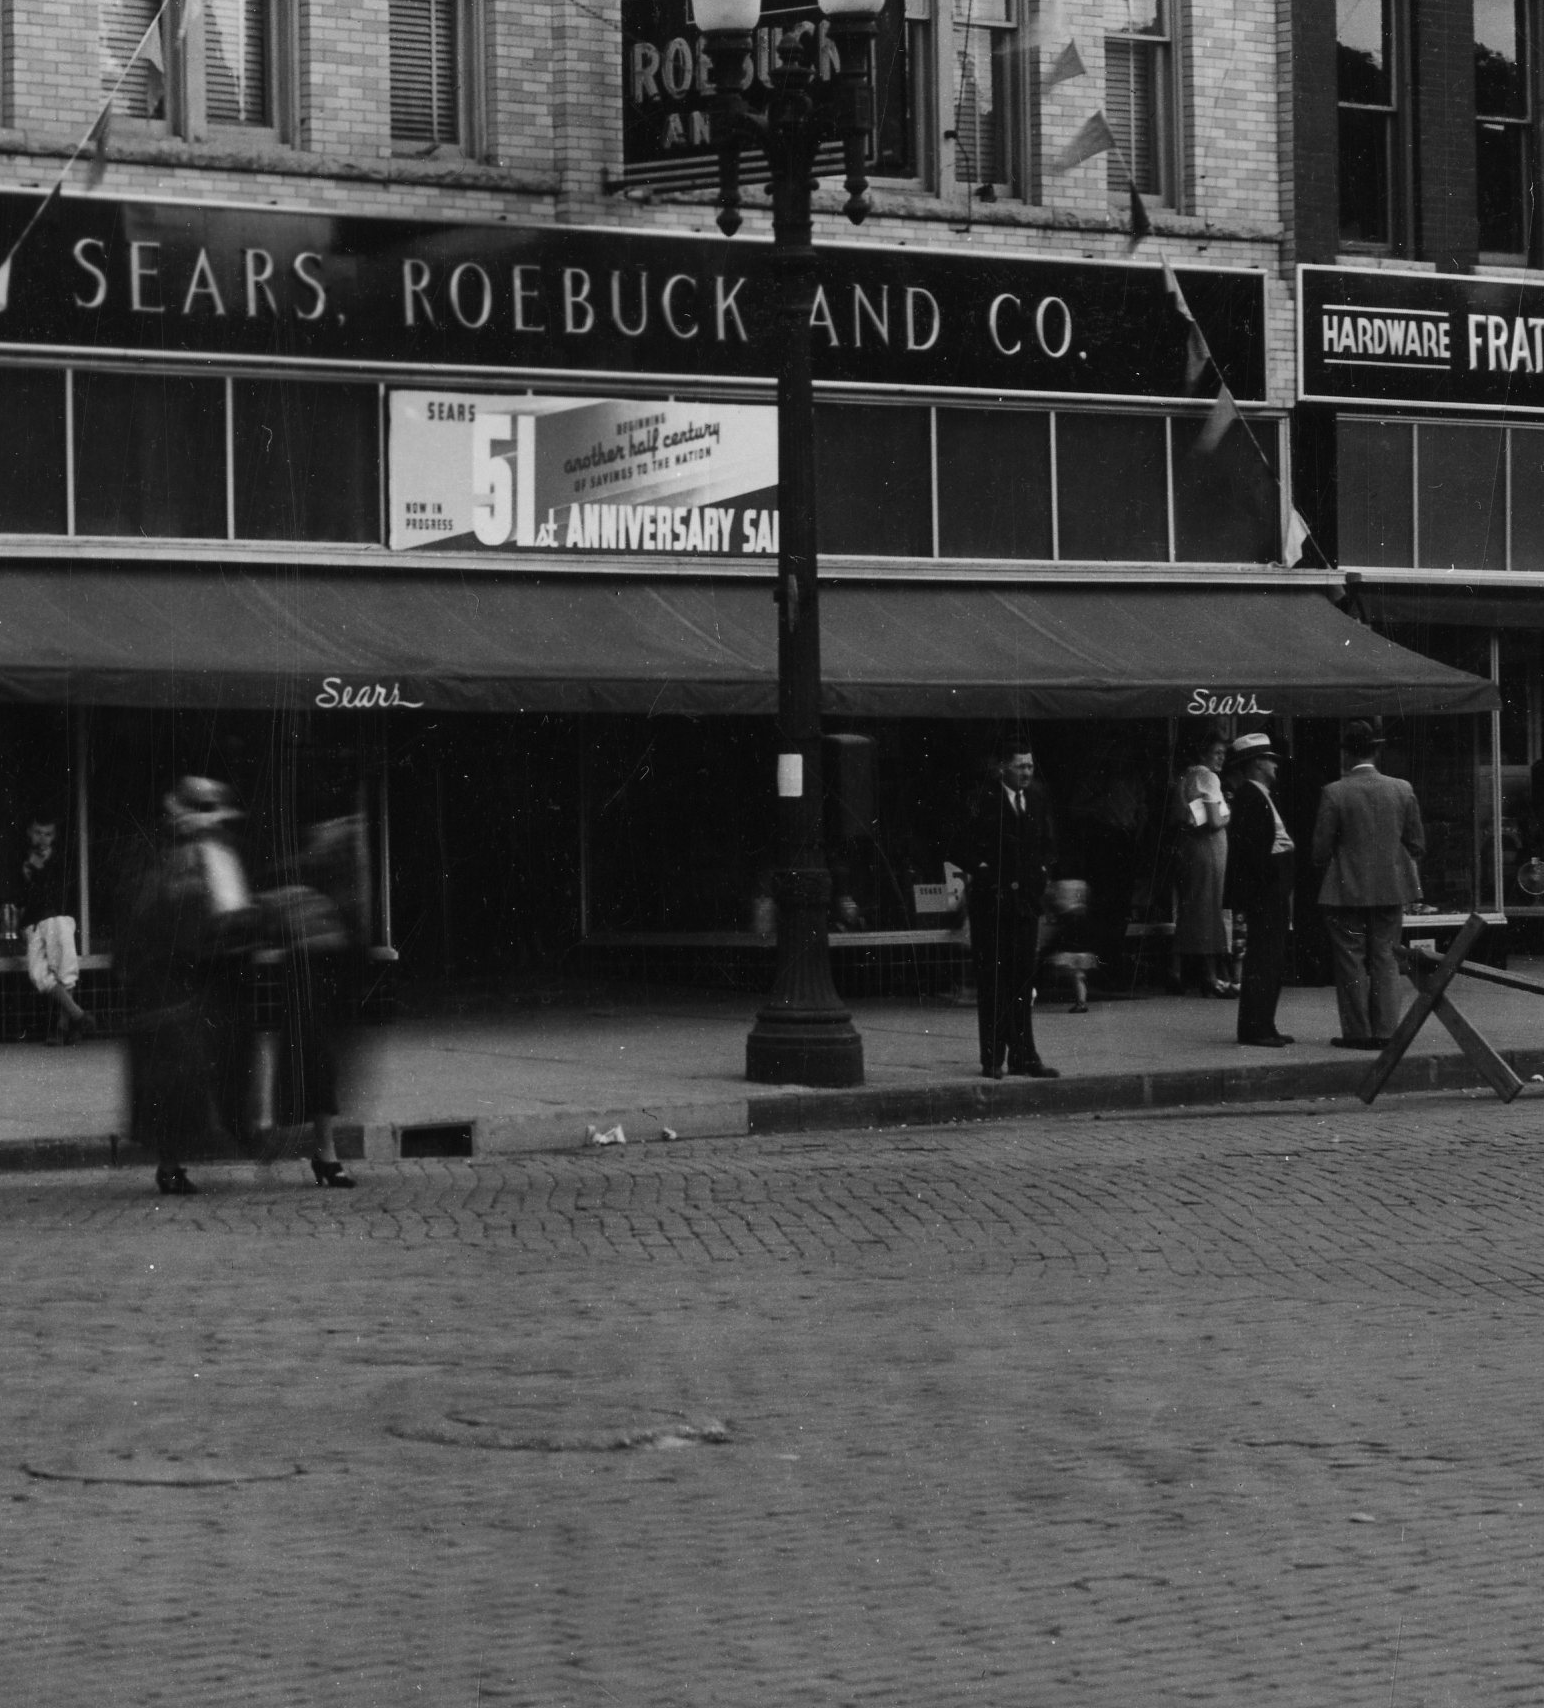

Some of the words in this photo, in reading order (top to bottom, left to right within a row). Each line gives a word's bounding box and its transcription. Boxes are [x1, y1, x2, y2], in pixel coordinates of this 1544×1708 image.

[72, 237, 346, 326] SEARS,
[401, 258, 748, 343] ROEBUCK
[808, 283, 941, 351] AND
[988, 293, 1088, 360] CO.
[1321, 314, 1451, 359] HARDWARE
[426, 401, 476, 423] SEARS
[615, 412, 666, 436] BEGINNING
[563, 441, 626, 474] another
[629, 427, 660, 458] half
[662, 421, 720, 444] century
[573, 478, 587, 492] OF
[590, 466, 633, 489] SAVINGS
[636, 462, 648, 476] TO
[651, 456, 670, 472] THE
[675, 446, 712, 466] NATION
[405, 502, 427, 514] NOW
[432, 503, 443, 514] IN
[405, 518, 454, 531] PROGRESS
[566, 502, 735, 554] ANNIVERSARY
[315, 677, 424, 710] Sears
[1187, 688, 1274, 716] Sears
